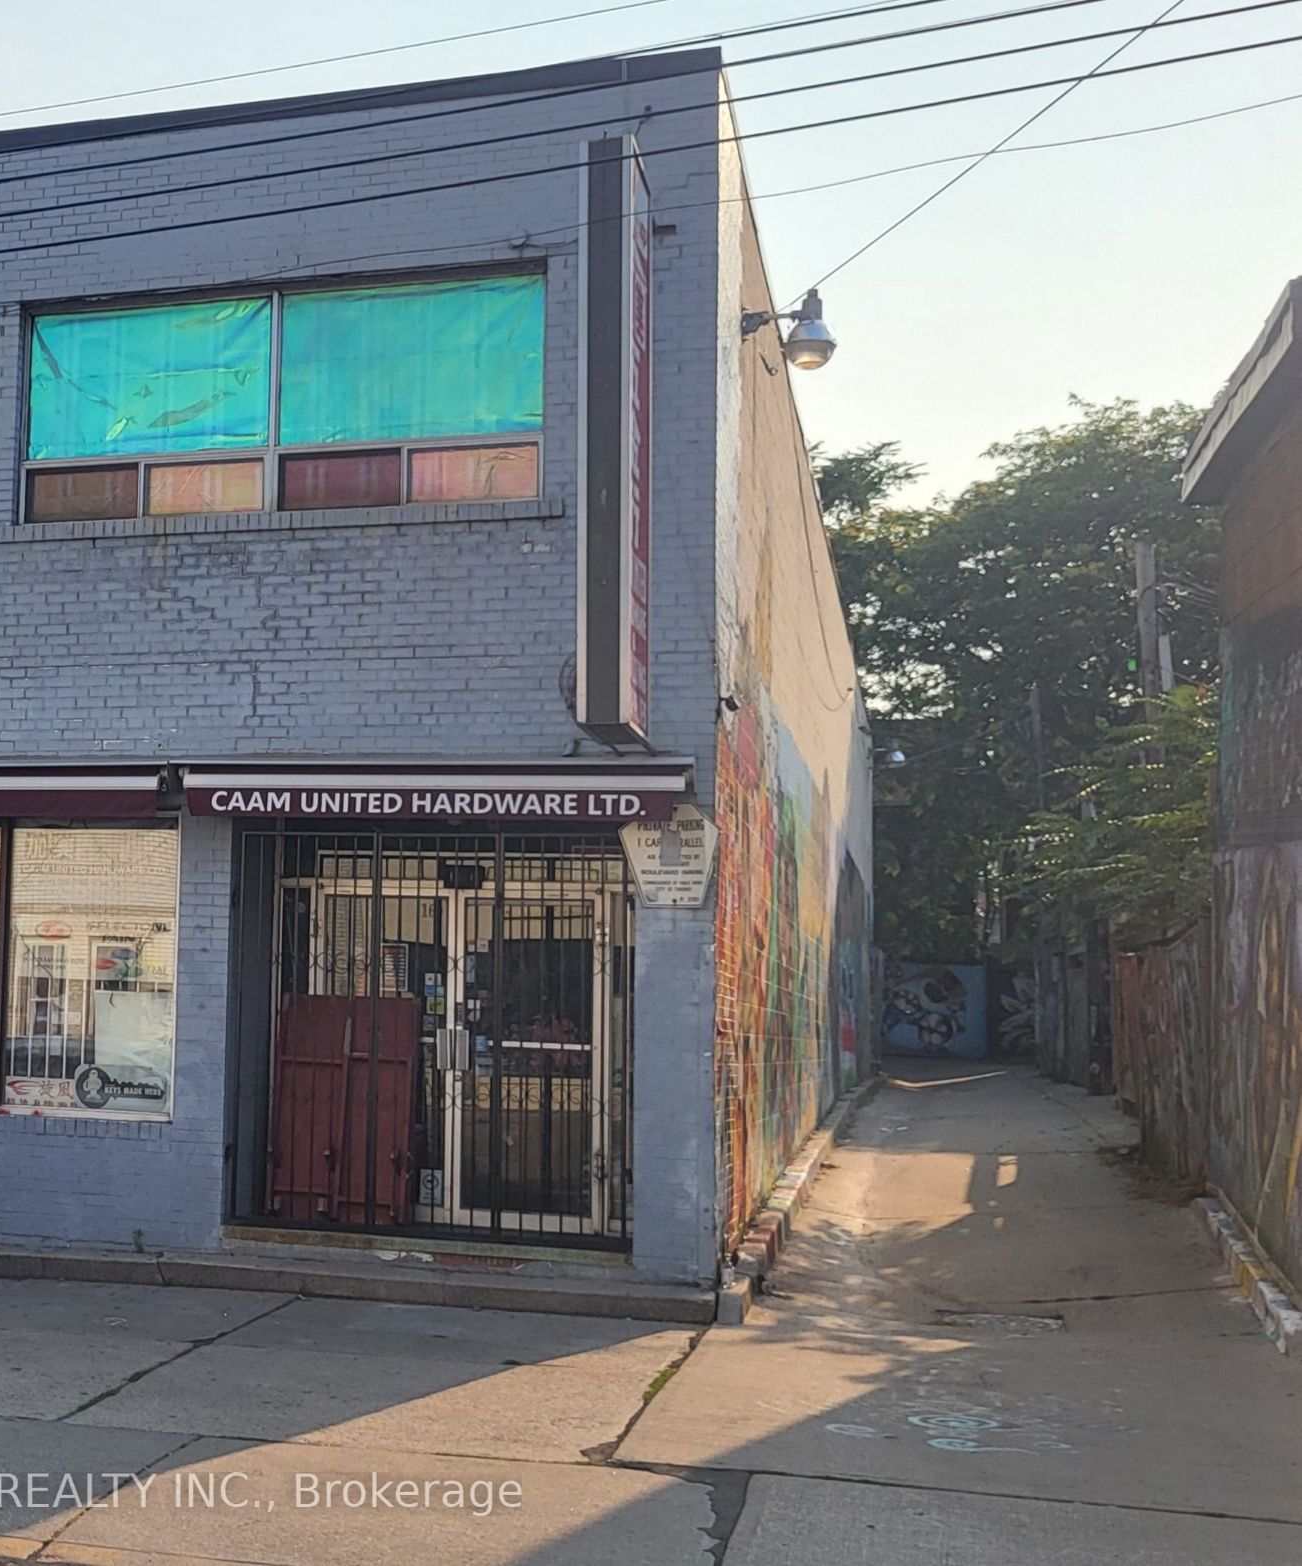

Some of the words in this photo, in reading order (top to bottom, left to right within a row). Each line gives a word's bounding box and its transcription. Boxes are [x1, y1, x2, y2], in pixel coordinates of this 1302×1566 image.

[211, 791, 291, 812] CAAM
[301, 792, 402, 814] UNITED
[412, 793, 578, 815] HARDWARE
[588, 794, 647, 816] LTD.
[104, 1086, 121, 1094] KEYS
[124, 1087, 141, 1095] MADE
[145, 1088, 161, 1096] HERE
